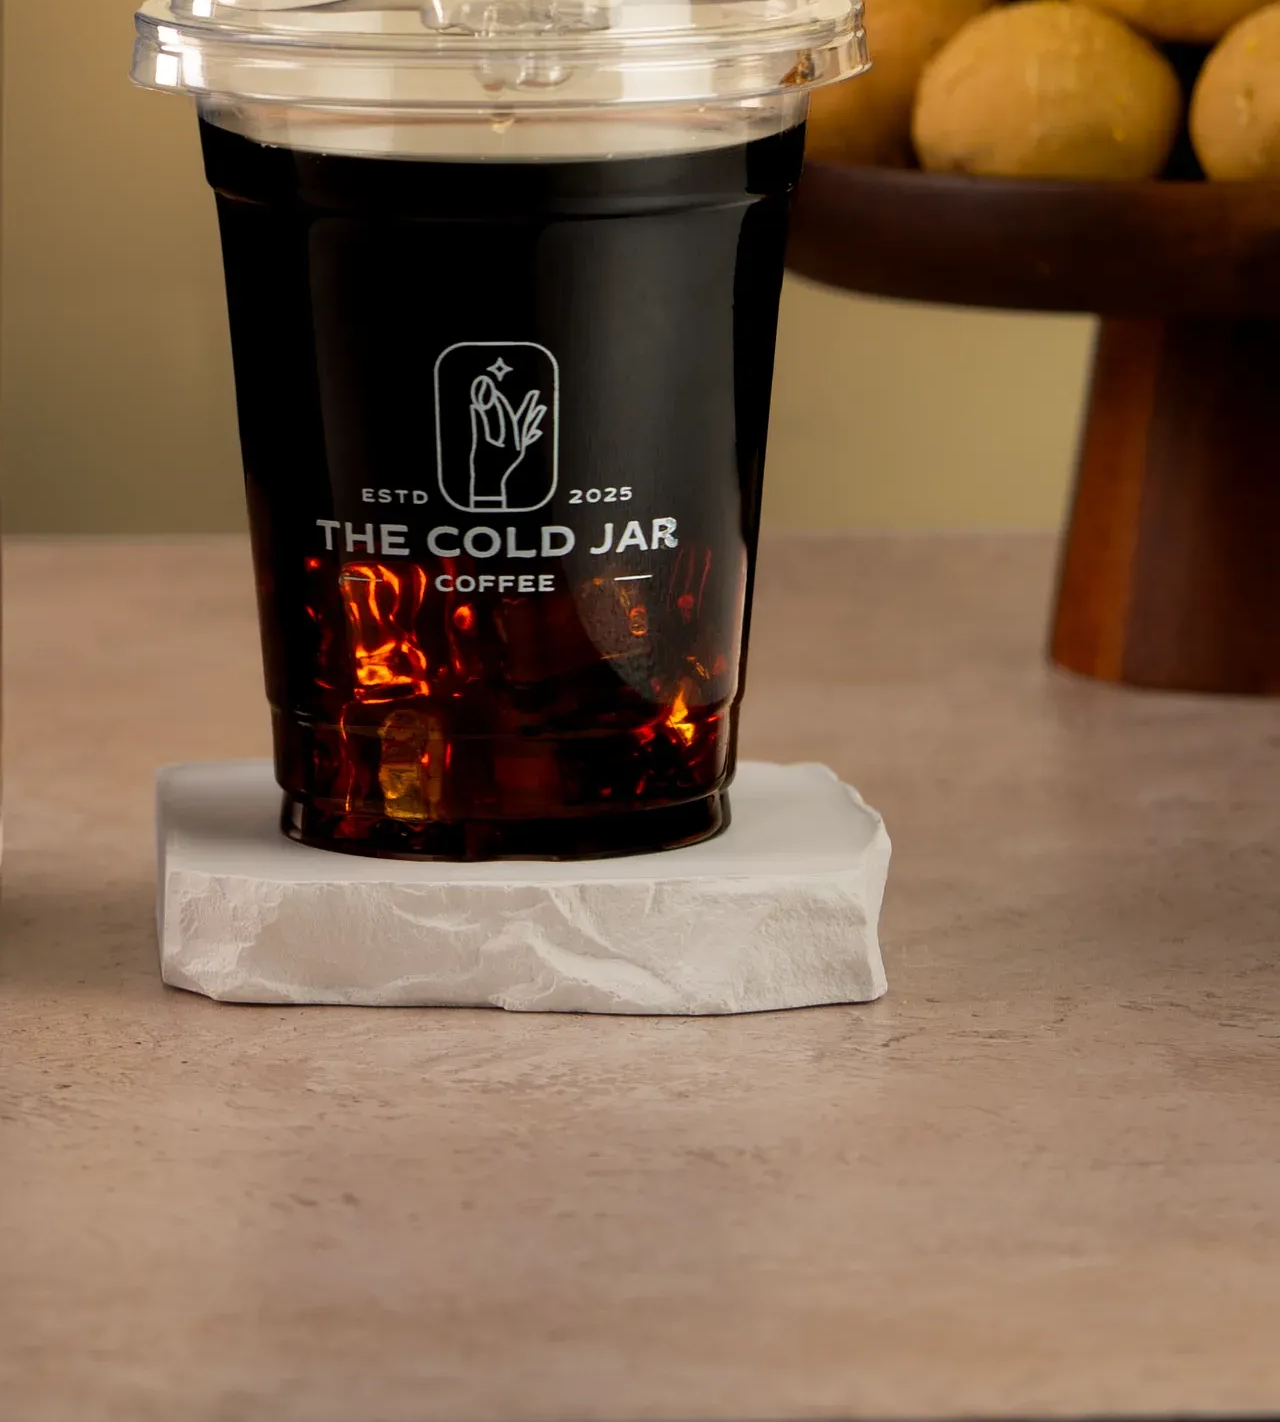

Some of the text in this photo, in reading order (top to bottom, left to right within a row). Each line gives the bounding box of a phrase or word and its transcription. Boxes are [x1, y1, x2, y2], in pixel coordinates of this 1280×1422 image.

[363, 487, 632, 504] ESTD 2025
[317, 517, 678, 558] THE COLD JAR
[435, 575, 555, 593] COFFEE
